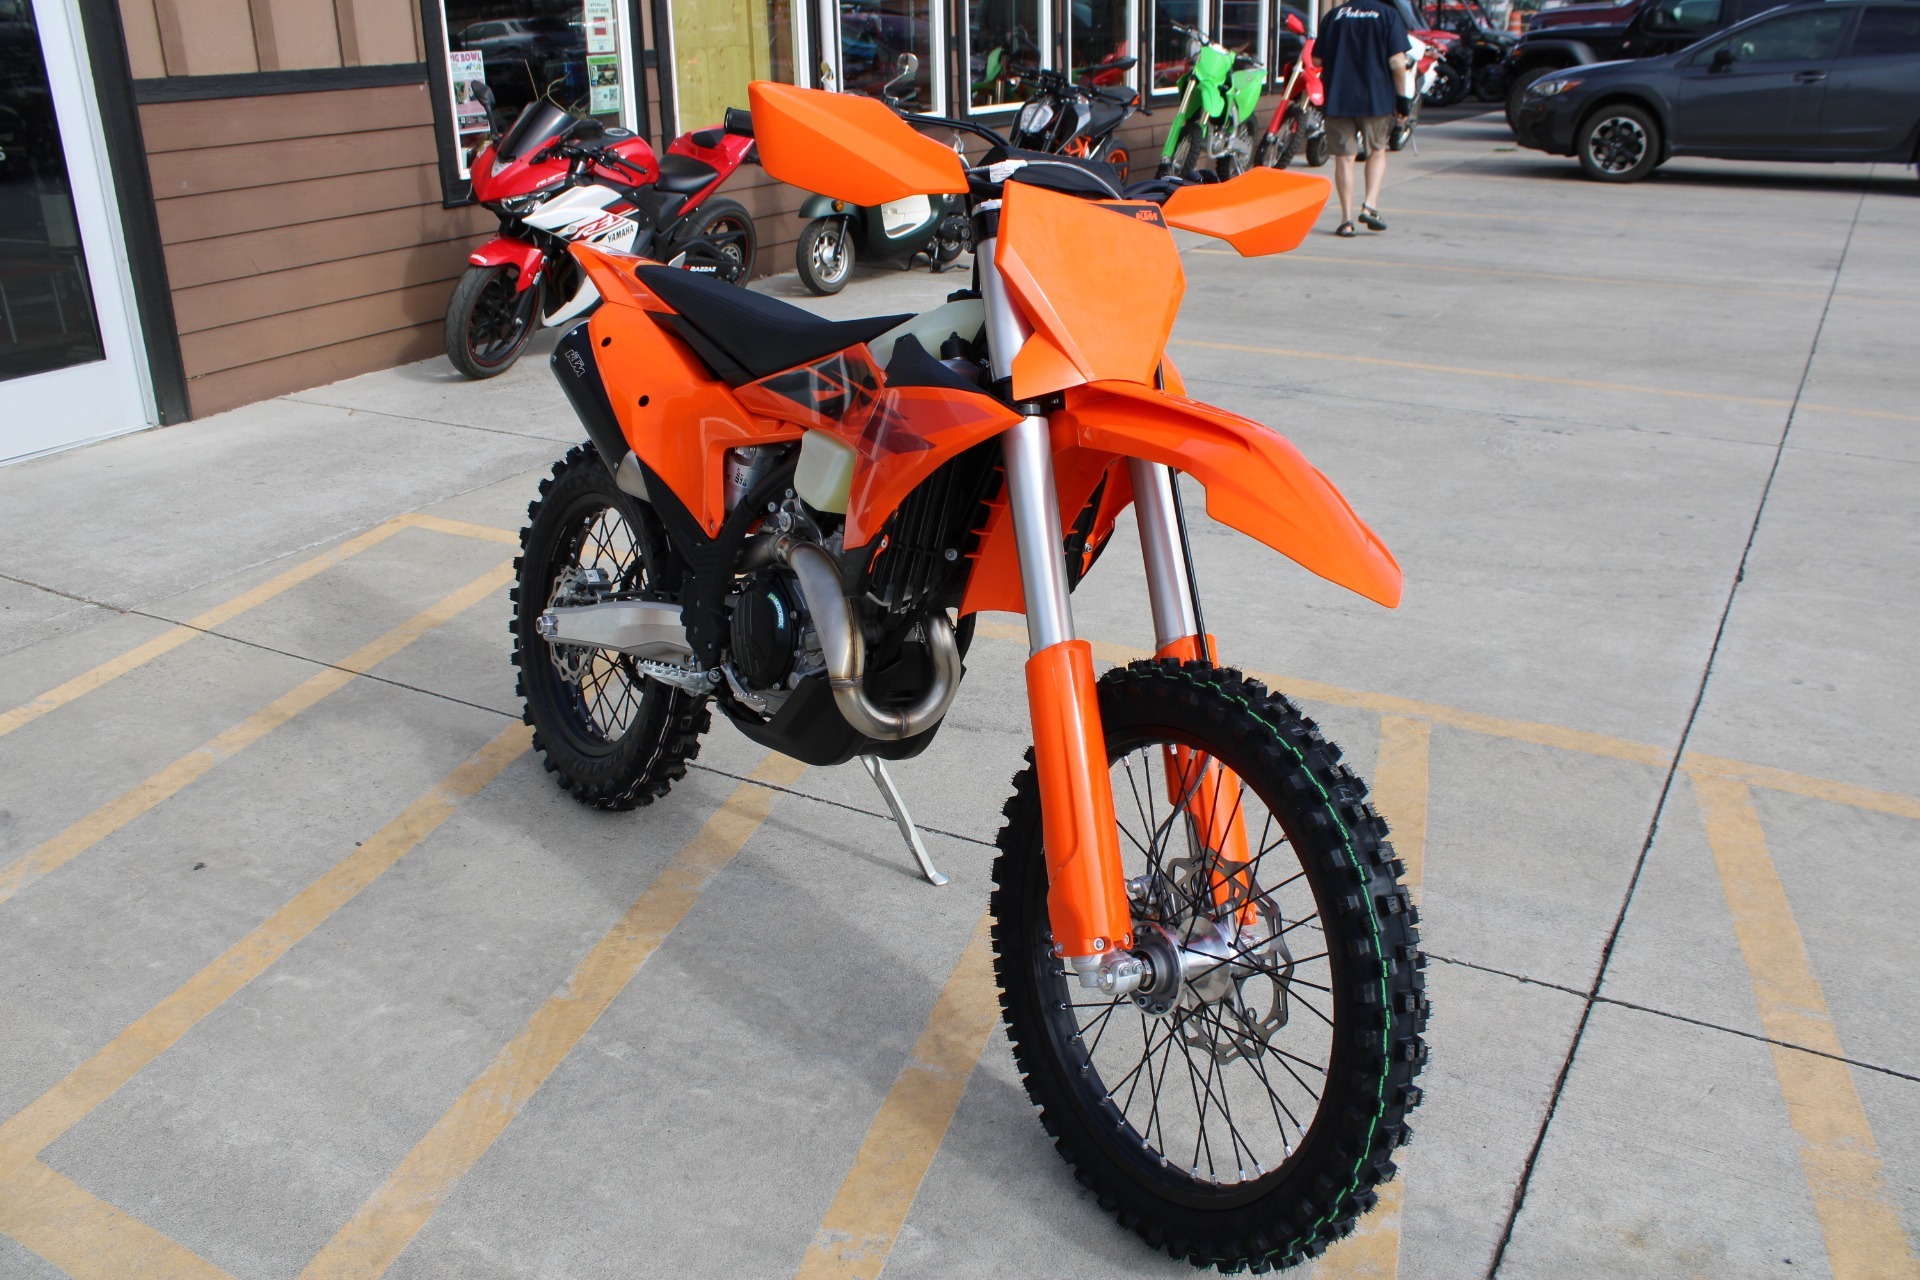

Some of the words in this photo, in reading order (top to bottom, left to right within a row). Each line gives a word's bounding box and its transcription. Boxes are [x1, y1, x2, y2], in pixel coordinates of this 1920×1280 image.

[1334, 6, 1380, 21] Polaris
[1136, 210, 1158, 221] KTM
[607, 224, 634, 244] YAMAHA
[565, 349, 586, 378] KTM
[772, 598, 784, 628] MOTOREX
